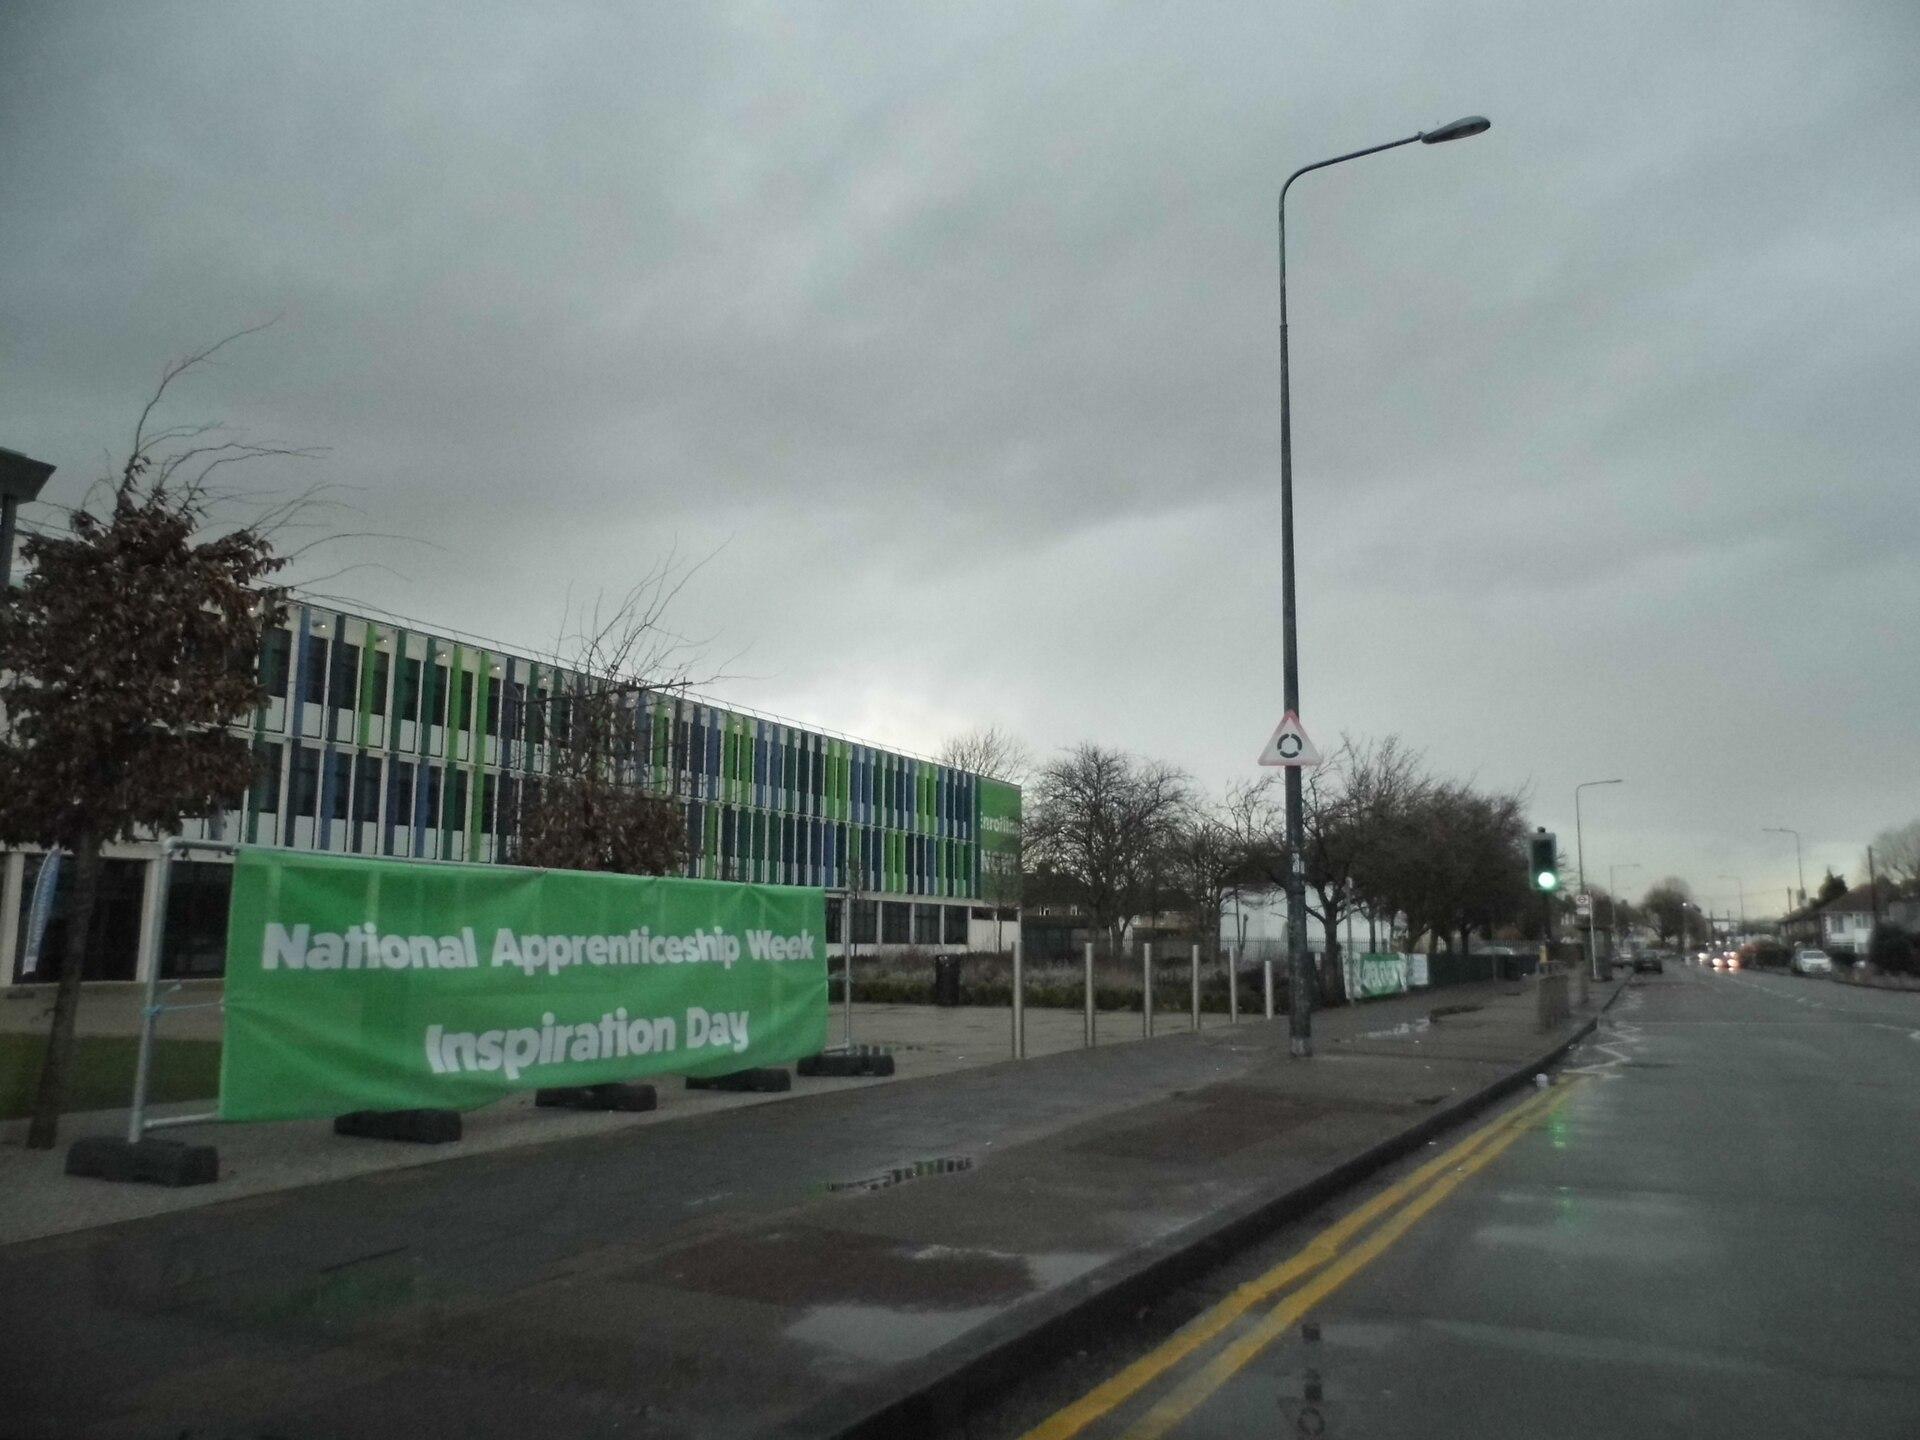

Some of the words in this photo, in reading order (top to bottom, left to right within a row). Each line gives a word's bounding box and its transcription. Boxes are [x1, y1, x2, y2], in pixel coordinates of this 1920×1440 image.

[262, 921, 478, 971] National
[491, 925, 741, 977] Apprenticeship
[745, 928, 815, 962] Week
[425, 1008, 677, 1080] Inspiration
[685, 1007, 750, 1054] Day
